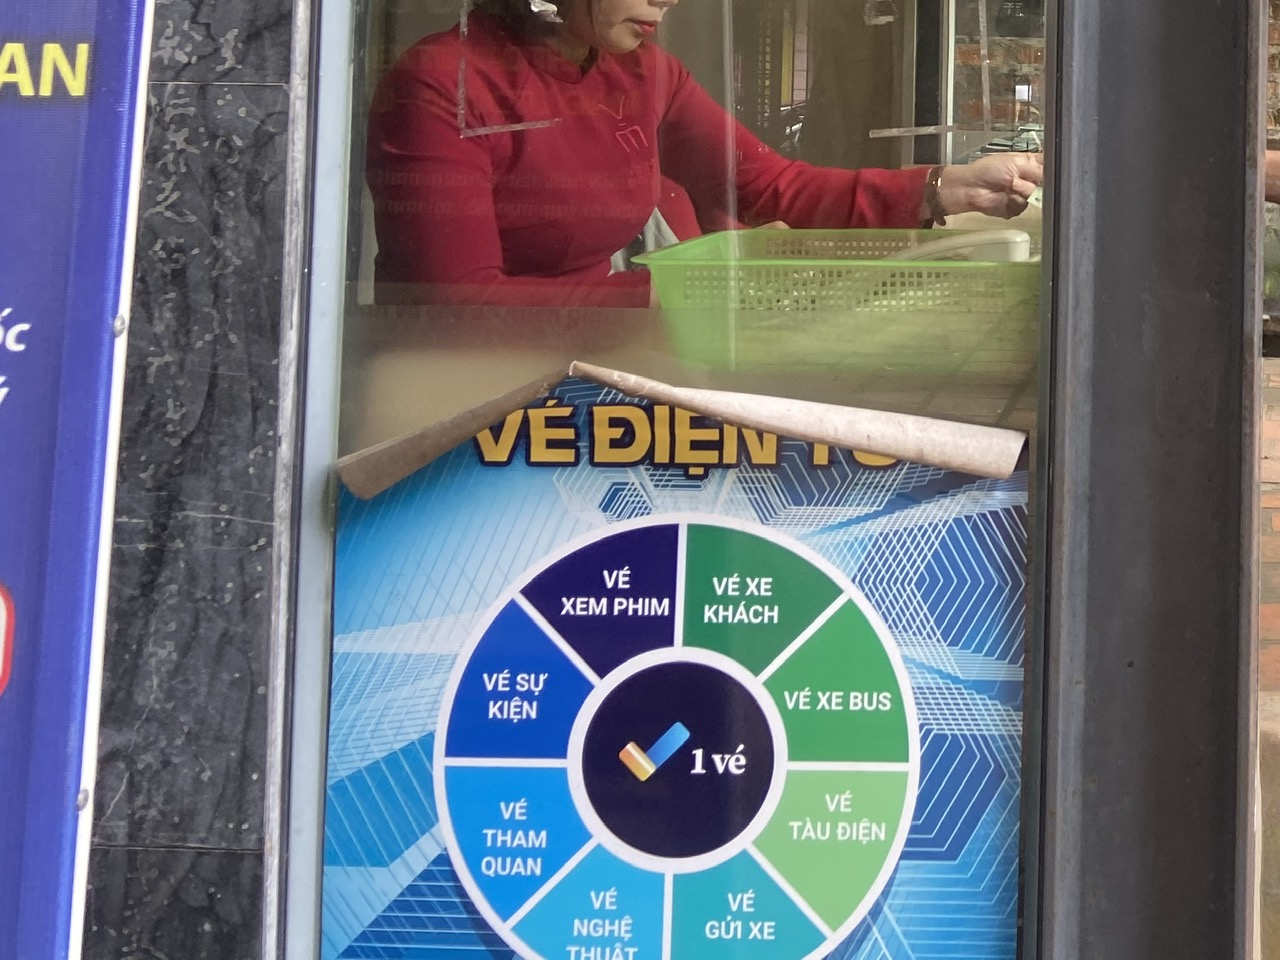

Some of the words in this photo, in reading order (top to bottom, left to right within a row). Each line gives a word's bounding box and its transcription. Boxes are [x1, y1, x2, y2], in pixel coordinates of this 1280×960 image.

[474, 399, 576, 464] VÉ
[603, 566, 631, 589] VÉ
[712, 573, 740, 596] VÉ
[745, 577, 773, 597] XE
[560, 597, 608, 616] XEM
[613, 597, 670, 617] PHIM
[703, 601, 779, 624] KHÁCH
[483, 669, 510, 691] VÉ
[515, 672, 549, 695] SỰ
[488, 697, 538, 723] KIỆN
[784, 687, 811, 710] VÉ
[816, 691, 844, 710] XE
[849, 691, 892, 711] BUS
[690, 748, 706, 774] 1
[711, 744, 746, 775] vé
[500, 798, 528, 820] VÉ
[825, 790, 852, 812] VÉ
[482, 830, 547, 849] THAM
[789, 817, 831, 841] TÀU
[836, 818, 886, 844] ĐIỆN
[481, 857, 542, 877] QUAN
[590, 887, 618, 910] VÉ
[727, 889, 755, 912] VÉ
[573, 915, 633, 942] NGHỆ
[705, 915, 743, 940] GỬI
[748, 921, 776, 940] XE
